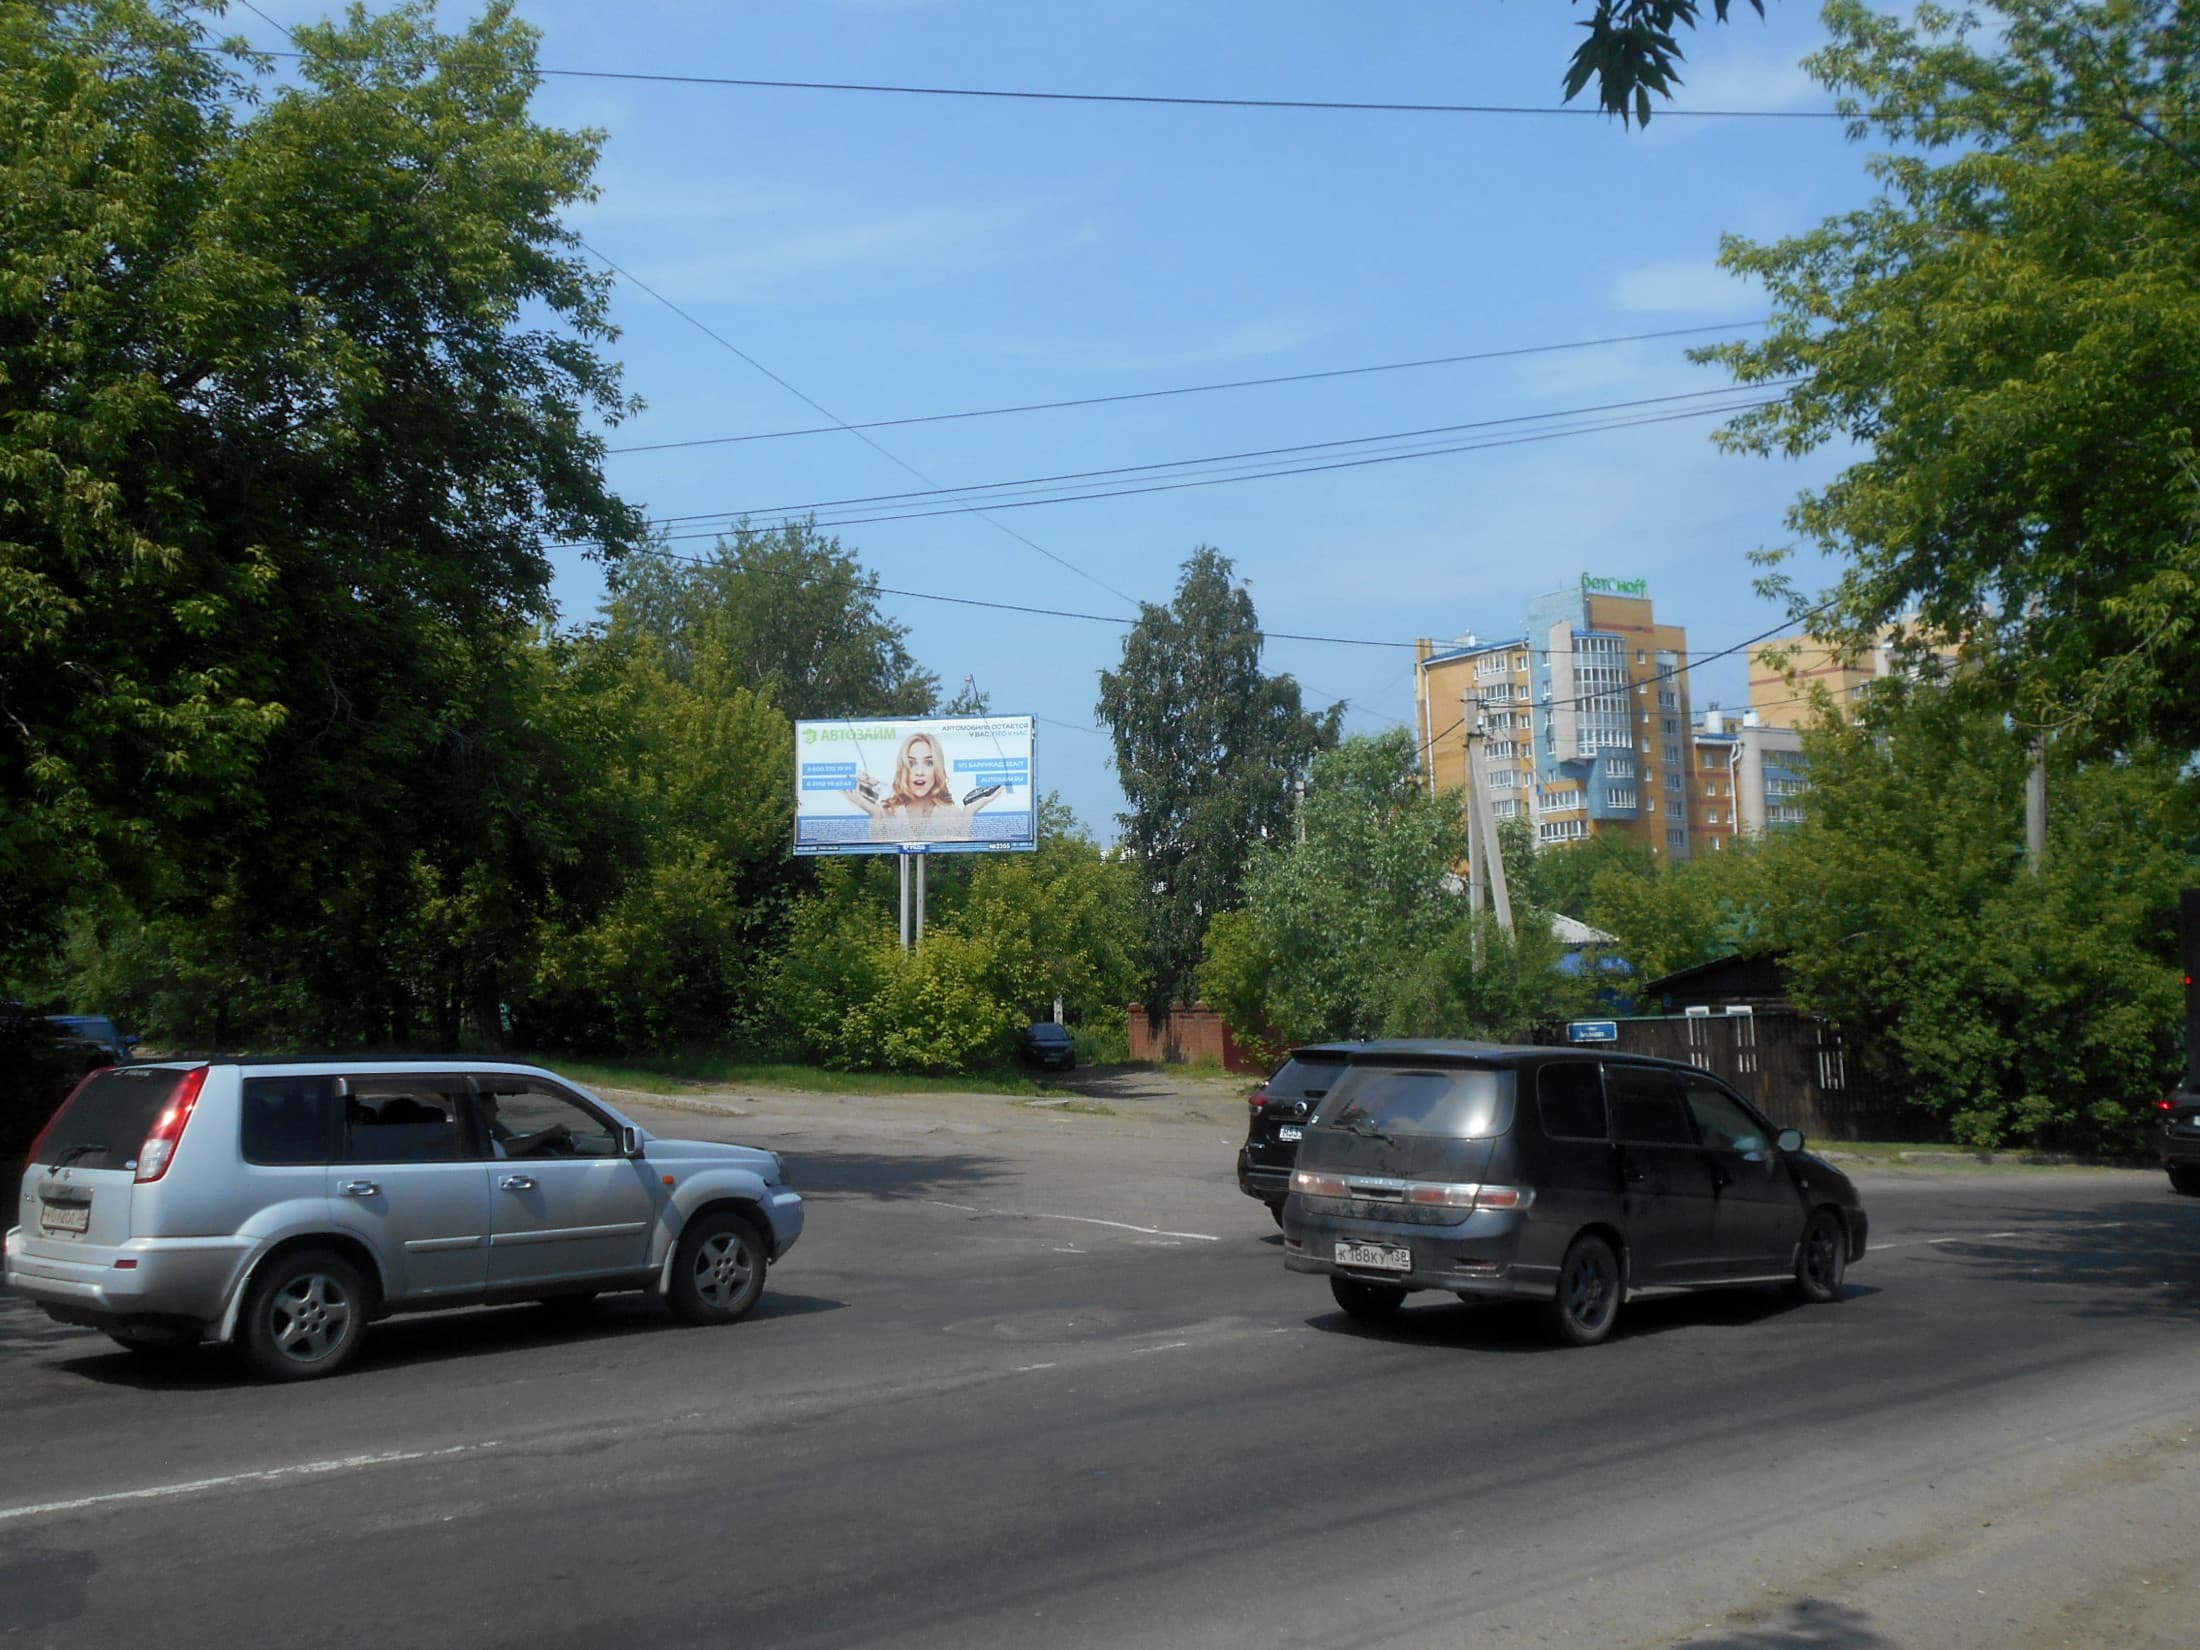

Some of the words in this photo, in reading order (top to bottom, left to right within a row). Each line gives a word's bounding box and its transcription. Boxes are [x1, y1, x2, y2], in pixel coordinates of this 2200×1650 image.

[991, 722, 1029, 730] ОСТАЕТСЯ
[820, 727, 896, 742] АВТОЗАЙМ
[1394, 1249, 1407, 1263] 38
